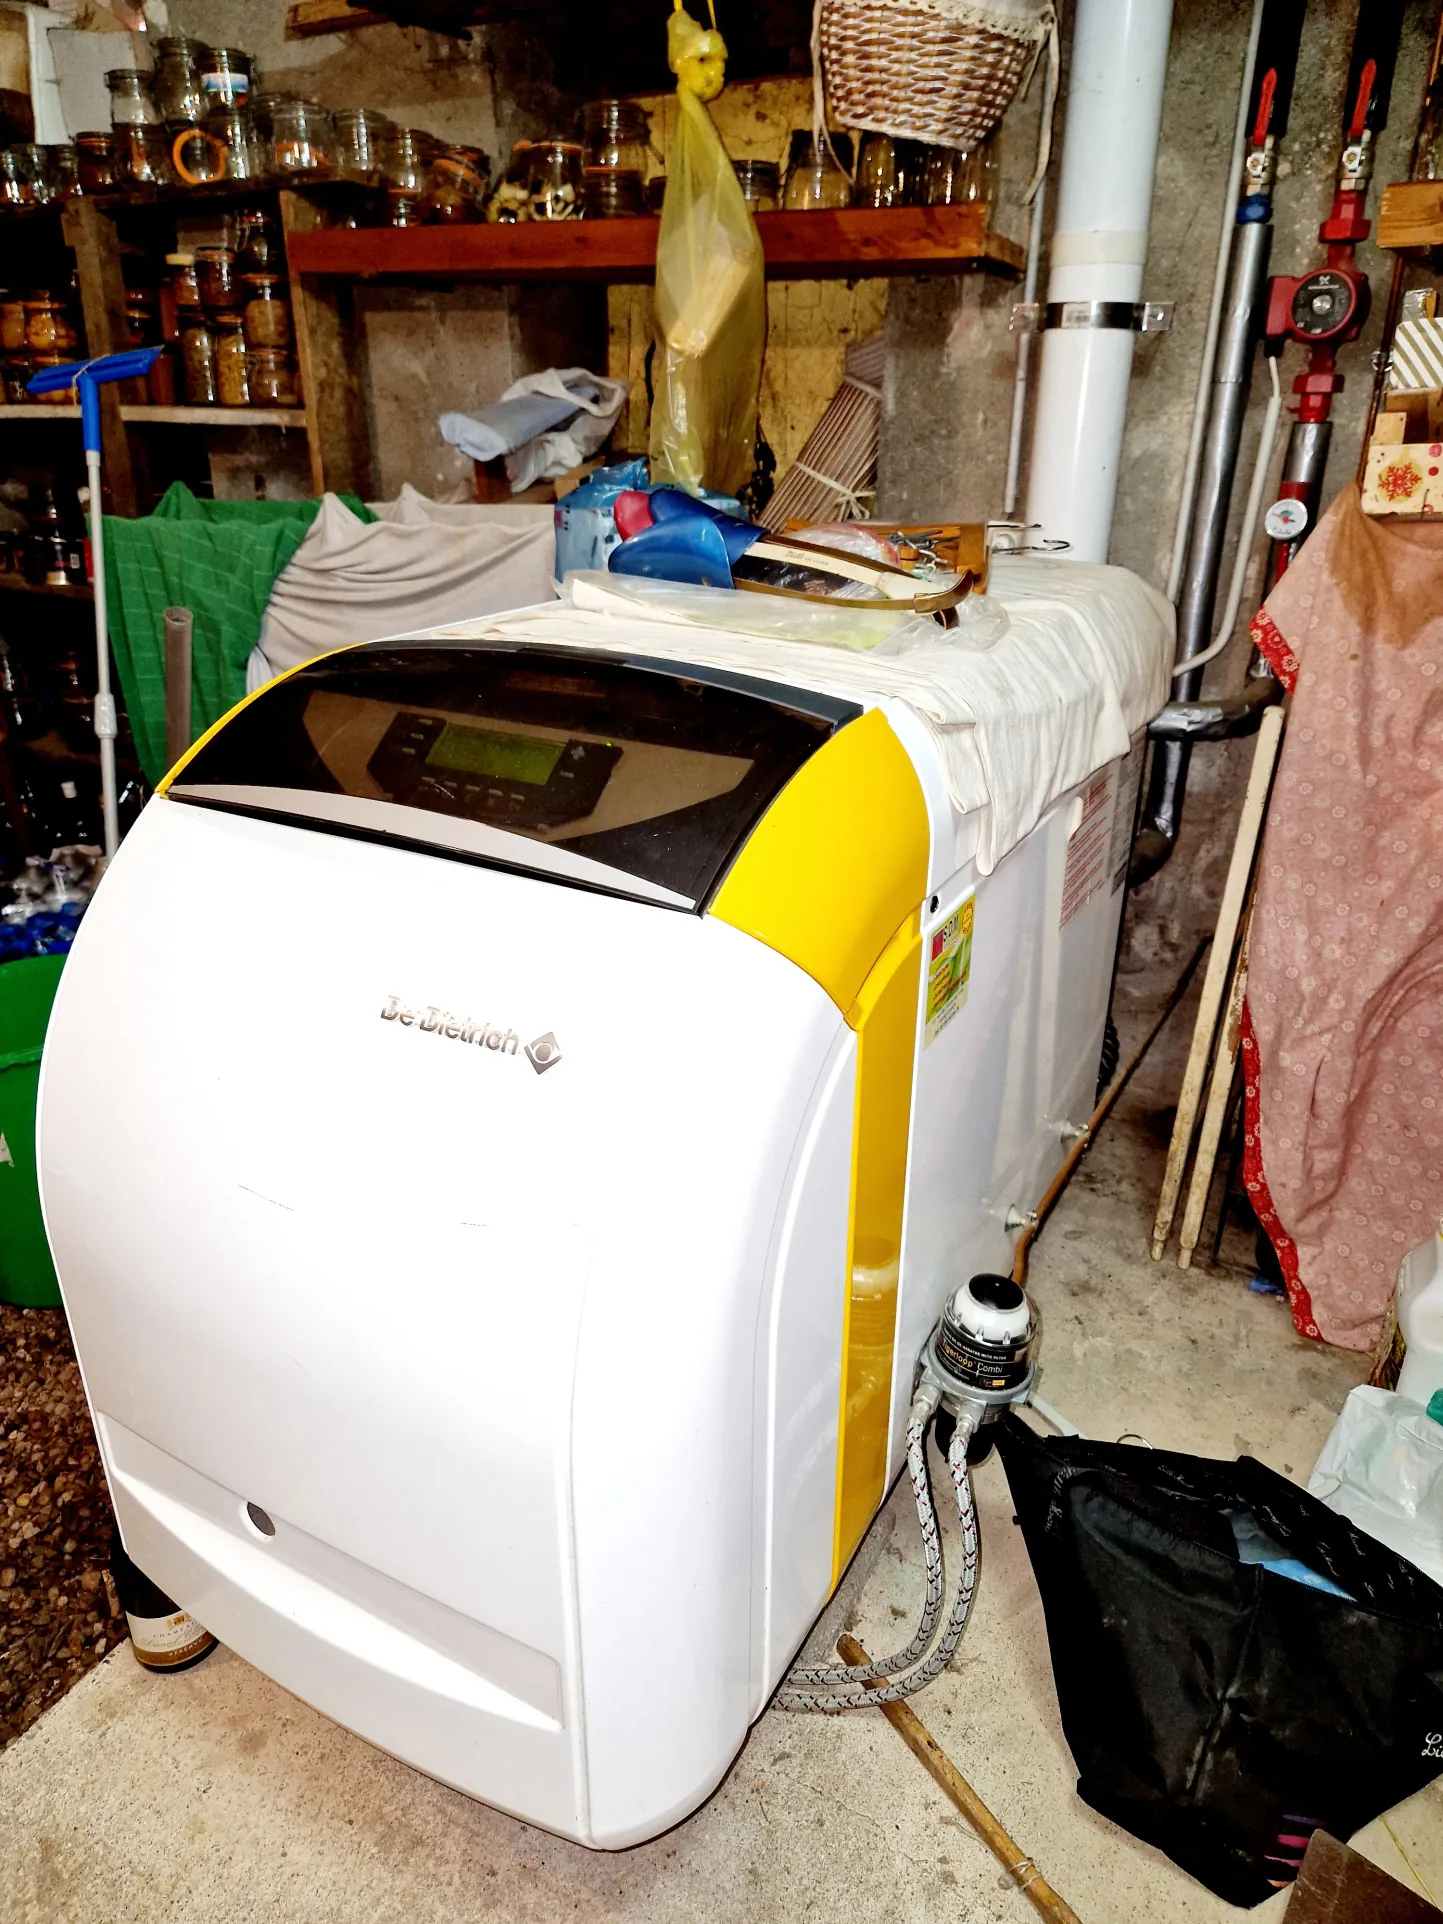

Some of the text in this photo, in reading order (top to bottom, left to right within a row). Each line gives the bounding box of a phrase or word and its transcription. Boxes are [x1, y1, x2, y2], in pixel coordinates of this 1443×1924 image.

[380, 994, 520, 1056] De Dietrich
[943, 1338, 973, 1368] Tigerloop
[977, 1362, 1003, 1374] Combi
